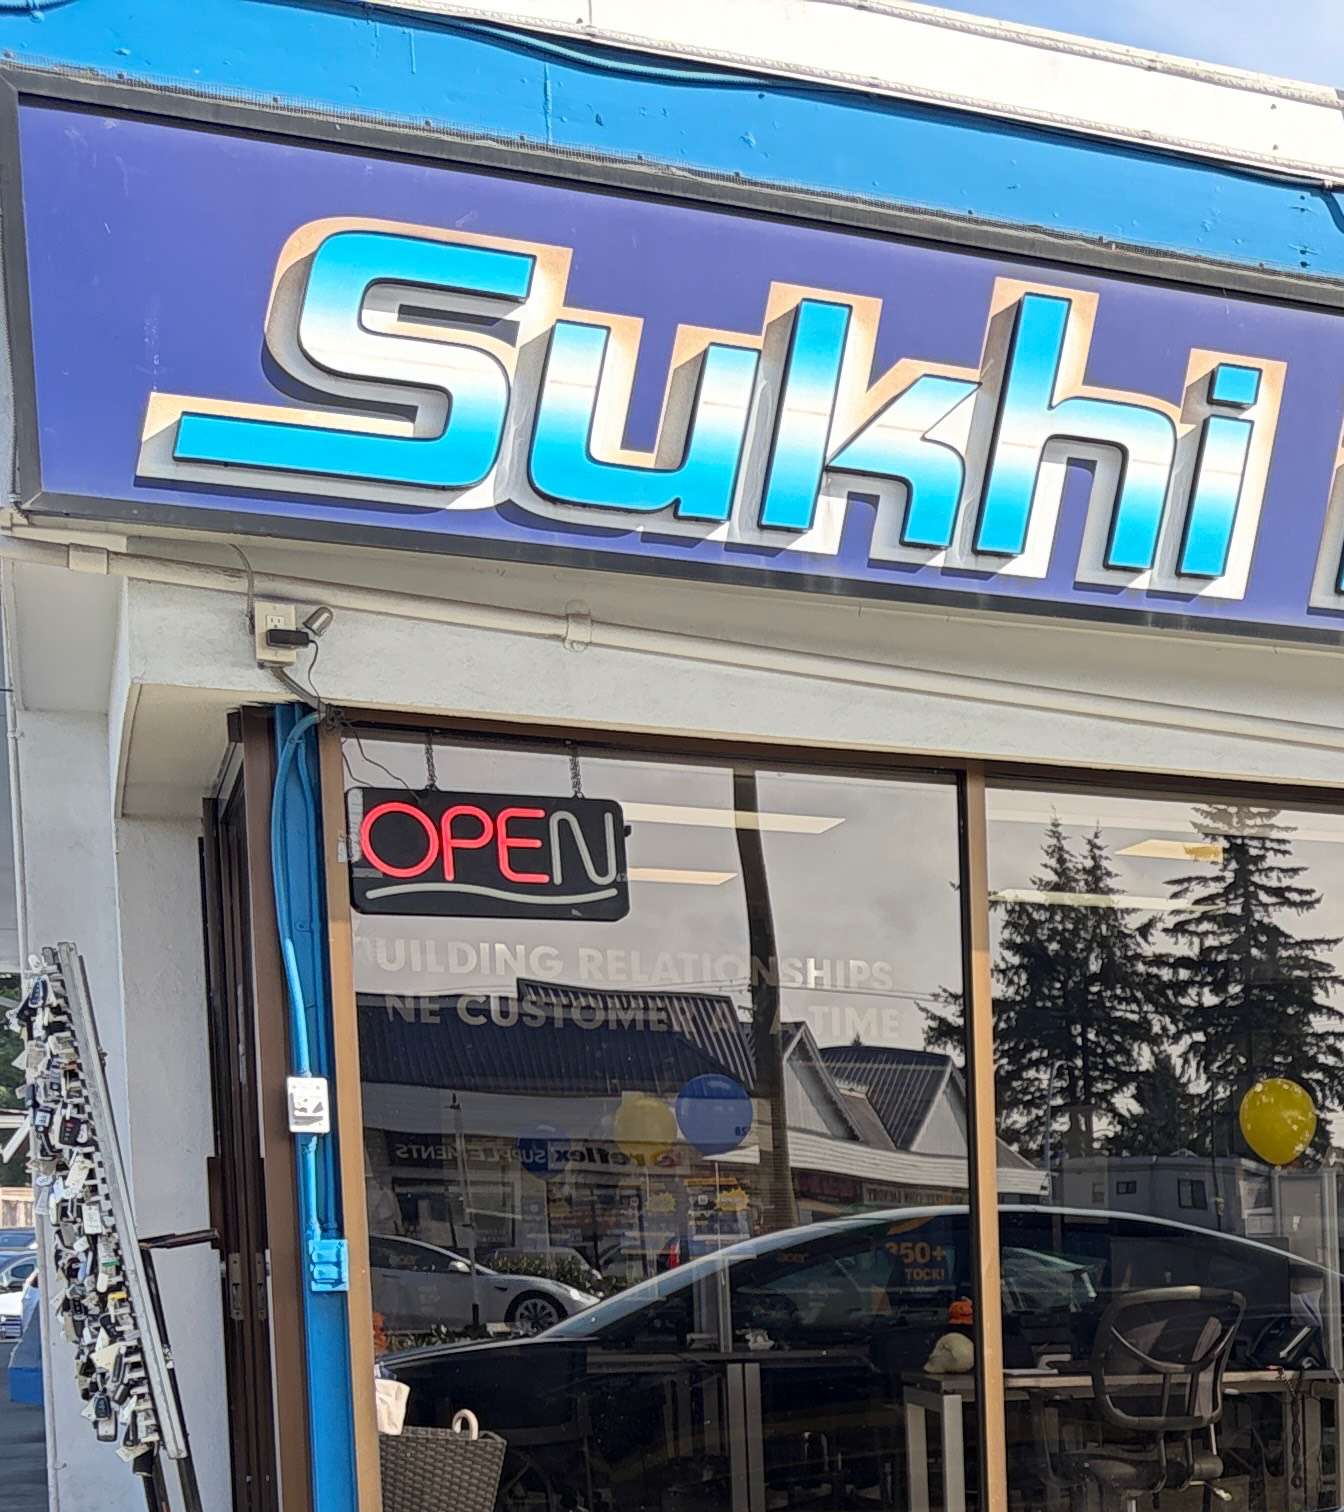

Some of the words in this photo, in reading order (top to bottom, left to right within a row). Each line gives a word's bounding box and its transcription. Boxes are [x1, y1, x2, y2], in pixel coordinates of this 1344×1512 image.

[150, 222, 1270, 590] Sukhi
[360, 801, 618, 884] OPEN
[578, 947, 893, 991] RELATIONSHIPS
[386, 995, 441, 1024] NE
[808, 1005, 899, 1039] TIME
